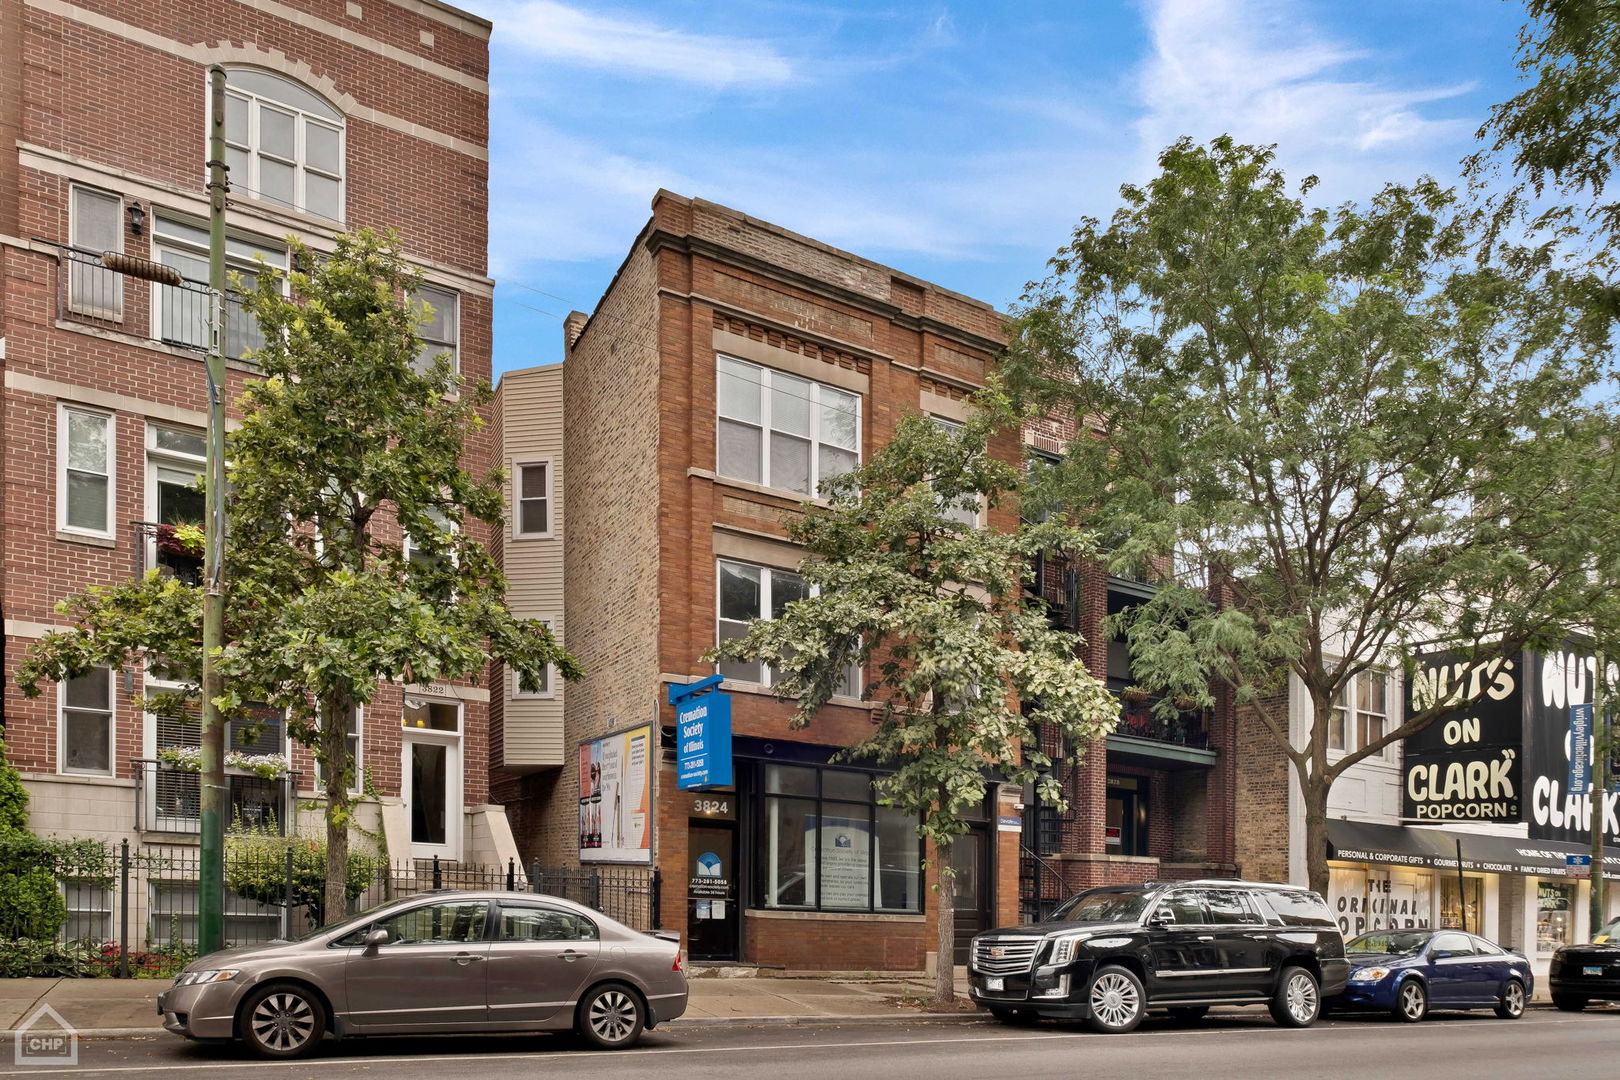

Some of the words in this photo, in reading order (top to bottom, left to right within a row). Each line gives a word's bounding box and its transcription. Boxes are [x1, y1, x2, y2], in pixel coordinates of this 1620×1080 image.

[422, 685, 444, 694] 3822
[1412, 657, 1515, 711] NUTS
[680, 705, 708, 724] Cremation
[683, 722, 704, 738] Society
[1443, 717, 1481, 745] ON
[1571, 708, 1588, 792] wrigleyvillechicago.org
[694, 800, 728, 813] 3824
[1416, 802, 1507, 819] POPCORN
[1338, 849, 1368, 860] PERSONAL
[1369, 852, 1374, 860] &
[1375, 853, 1408, 864] CORPORATE
[1408, 856, 1424, 864] GIFTS
[1433, 858, 1459, 867] GOURMET
[1483, 862, 1512, 872] CHOCOLATE
[1520, 865, 1536, 874] FANCY
[1338, 916, 1428, 936] OPCORN
